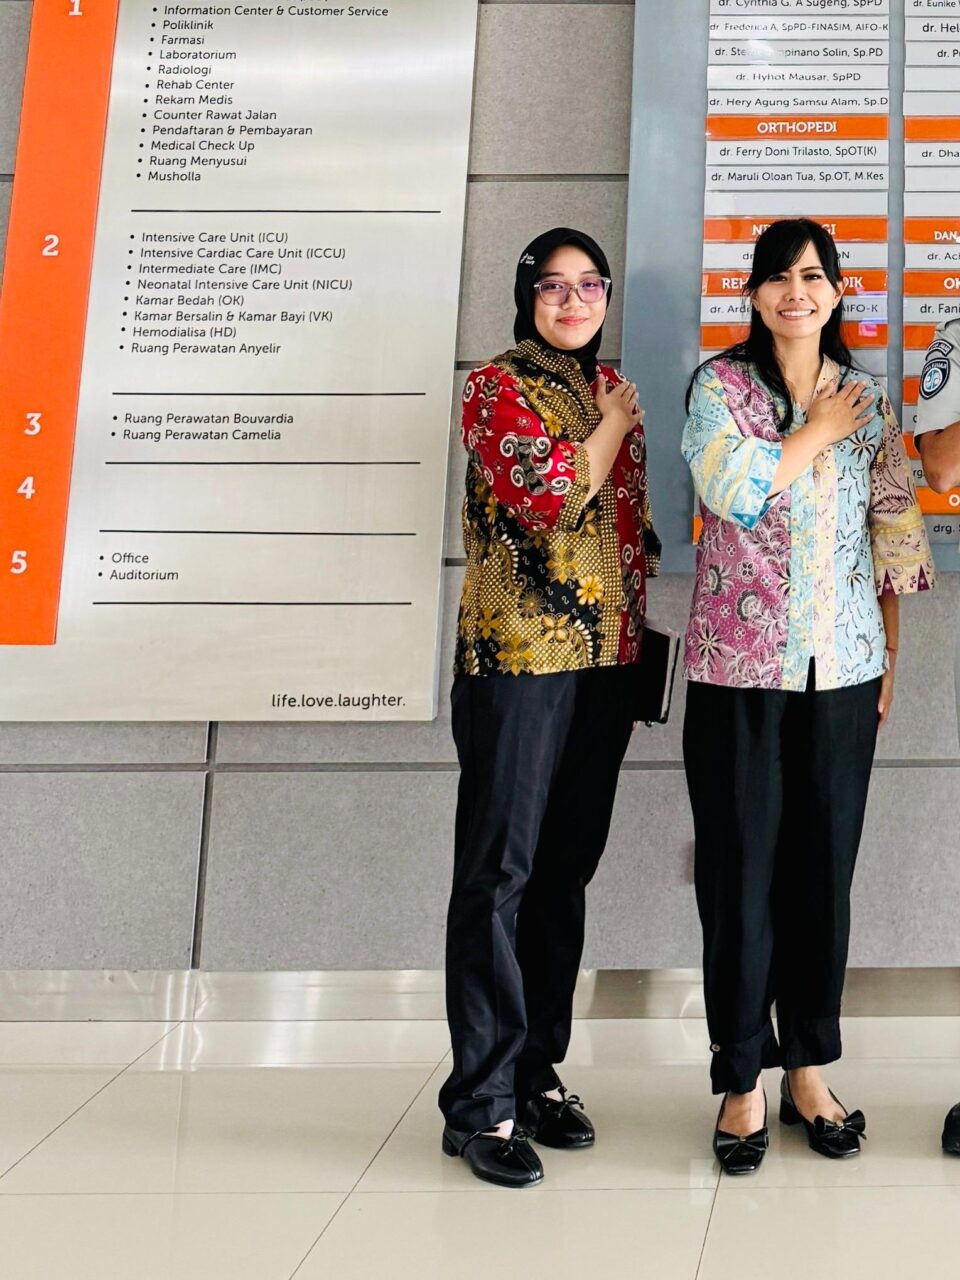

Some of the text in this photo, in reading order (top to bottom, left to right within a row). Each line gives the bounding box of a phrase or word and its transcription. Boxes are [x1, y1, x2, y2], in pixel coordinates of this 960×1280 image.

[164, 4, 389, 17] Information Center & Customer Service
[162, 19, 214, 31] Poliklinik
[921, 22, 937, 33] dr.
[161, 34, 205, 45] Farmasi
[159, 49, 237, 60] Laboratorium
[157, 64, 212, 78] Radiologi
[156, 79, 235, 90] Rehab Center
[155, 94, 233, 105] Rekam Medis
[153, 109, 277, 121] Counter Rawat Jalan
[152, 124, 313, 138] Pendaftaran & Pembayaran
[757, 121, 837, 134] ORTHOPEDI
[150, 139, 255, 153] Medical Check Up
[149, 155, 247, 169] Ruang Menyusui
[147, 170, 201, 182] Musholla
[141, 231, 289, 245] Intensive Care Unit (ICU)
[41, 233, 59, 257] 2
[140, 247, 346, 260] Intensive Cardiac Care Unit (ICCU)
[138, 263, 282, 275] Intermediate Care (IMC)
[137, 278, 353, 291] Neonatal Intensive Care Unit (NICU)
[135, 294, 245, 307] Kamar Bedah (OK)
[134, 310, 333, 325] Kamar Bersalin & Kamar Bayi (VK)
[132, 326, 237, 339] Hemodialisa (HD)
[131, 342, 282, 357] Ruang Perawatan Anyelir
[23, 412, 42, 436] 3
[124, 412, 294, 427] Ruang Perawatan Bouvardia
[123, 428, 281, 443] Ruang Perawatan Camelia
[16, 475, 36, 500] 4
[10, 549, 28, 575] 5
[111, 552, 150, 564] Office
[109, 569, 179, 581] Auditorium
[271, 693, 406, 711] life.love.laughter.
